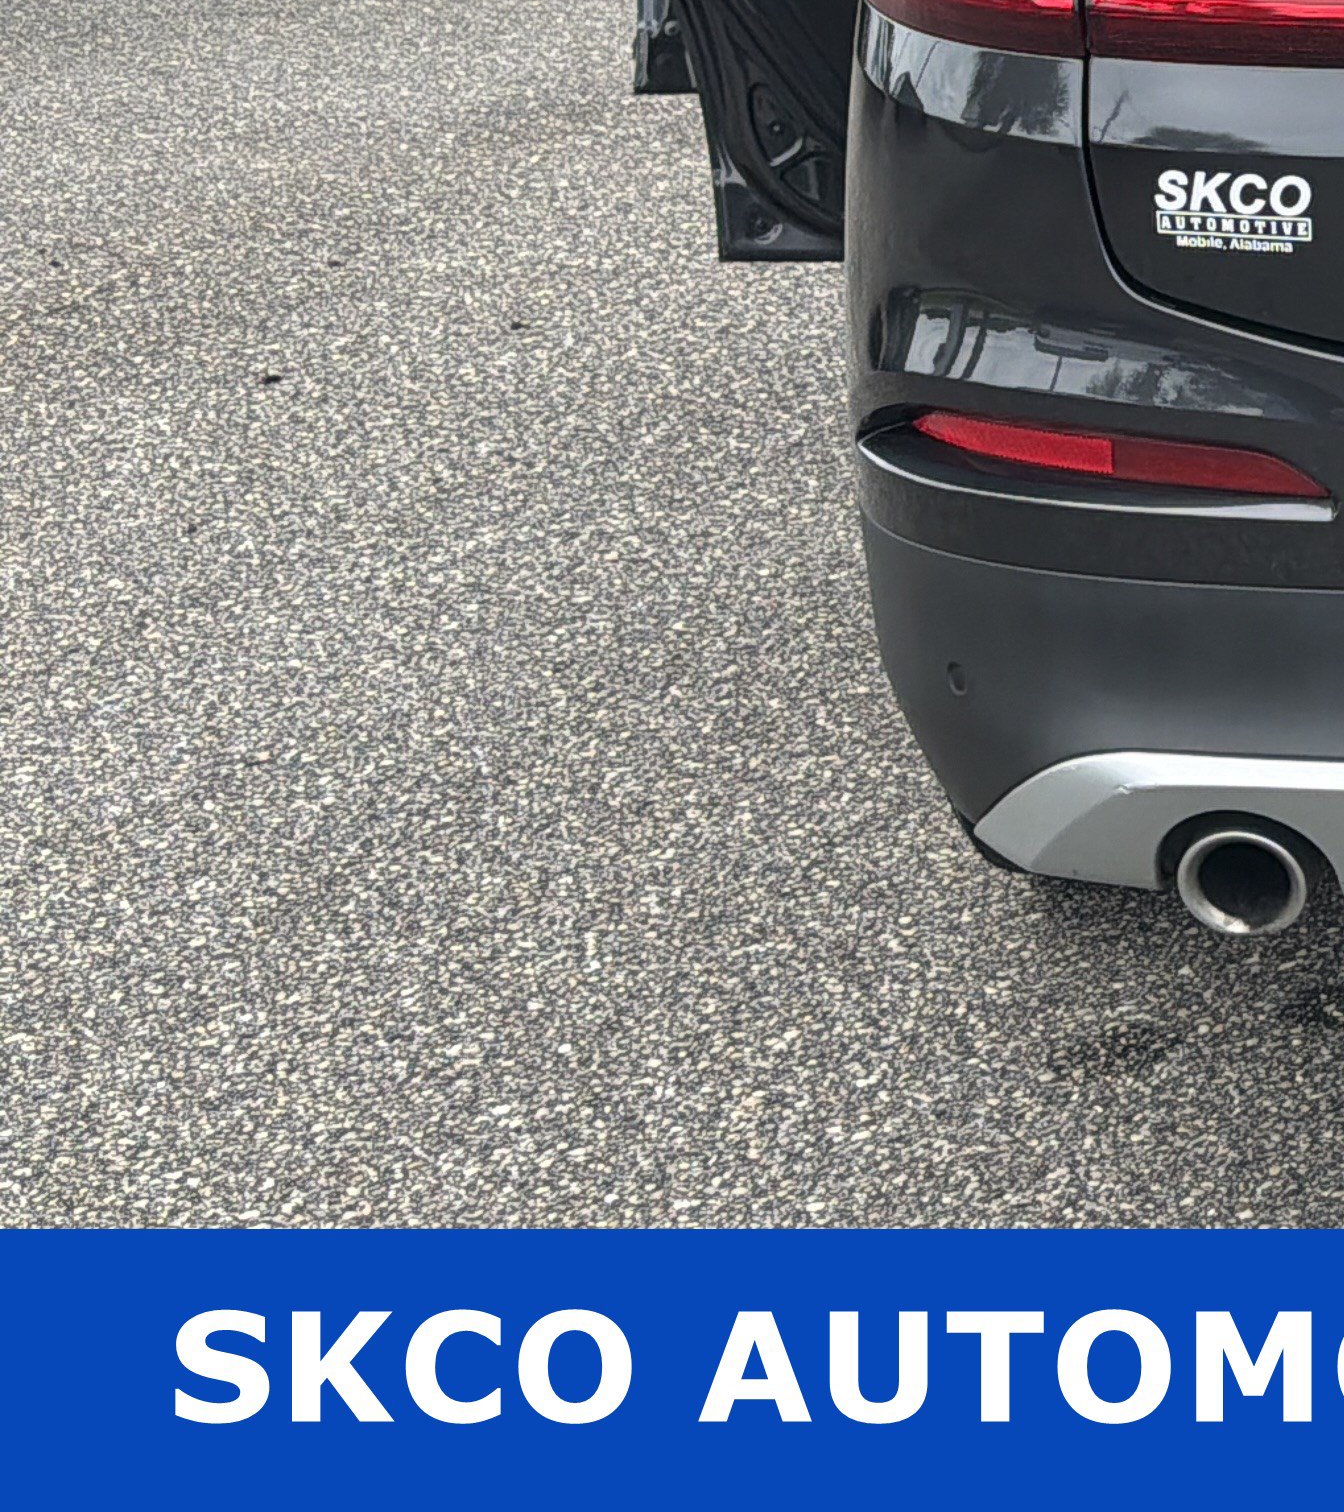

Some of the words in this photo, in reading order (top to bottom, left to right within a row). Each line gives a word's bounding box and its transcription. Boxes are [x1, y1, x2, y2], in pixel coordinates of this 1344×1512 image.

[1154, 170, 1312, 216] SKCO
[1160, 215, 1309, 236] AUTOMOTIVE
[1176, 235, 1227, 251] Mobile,
[1229, 239, 1294, 253] Alabama
